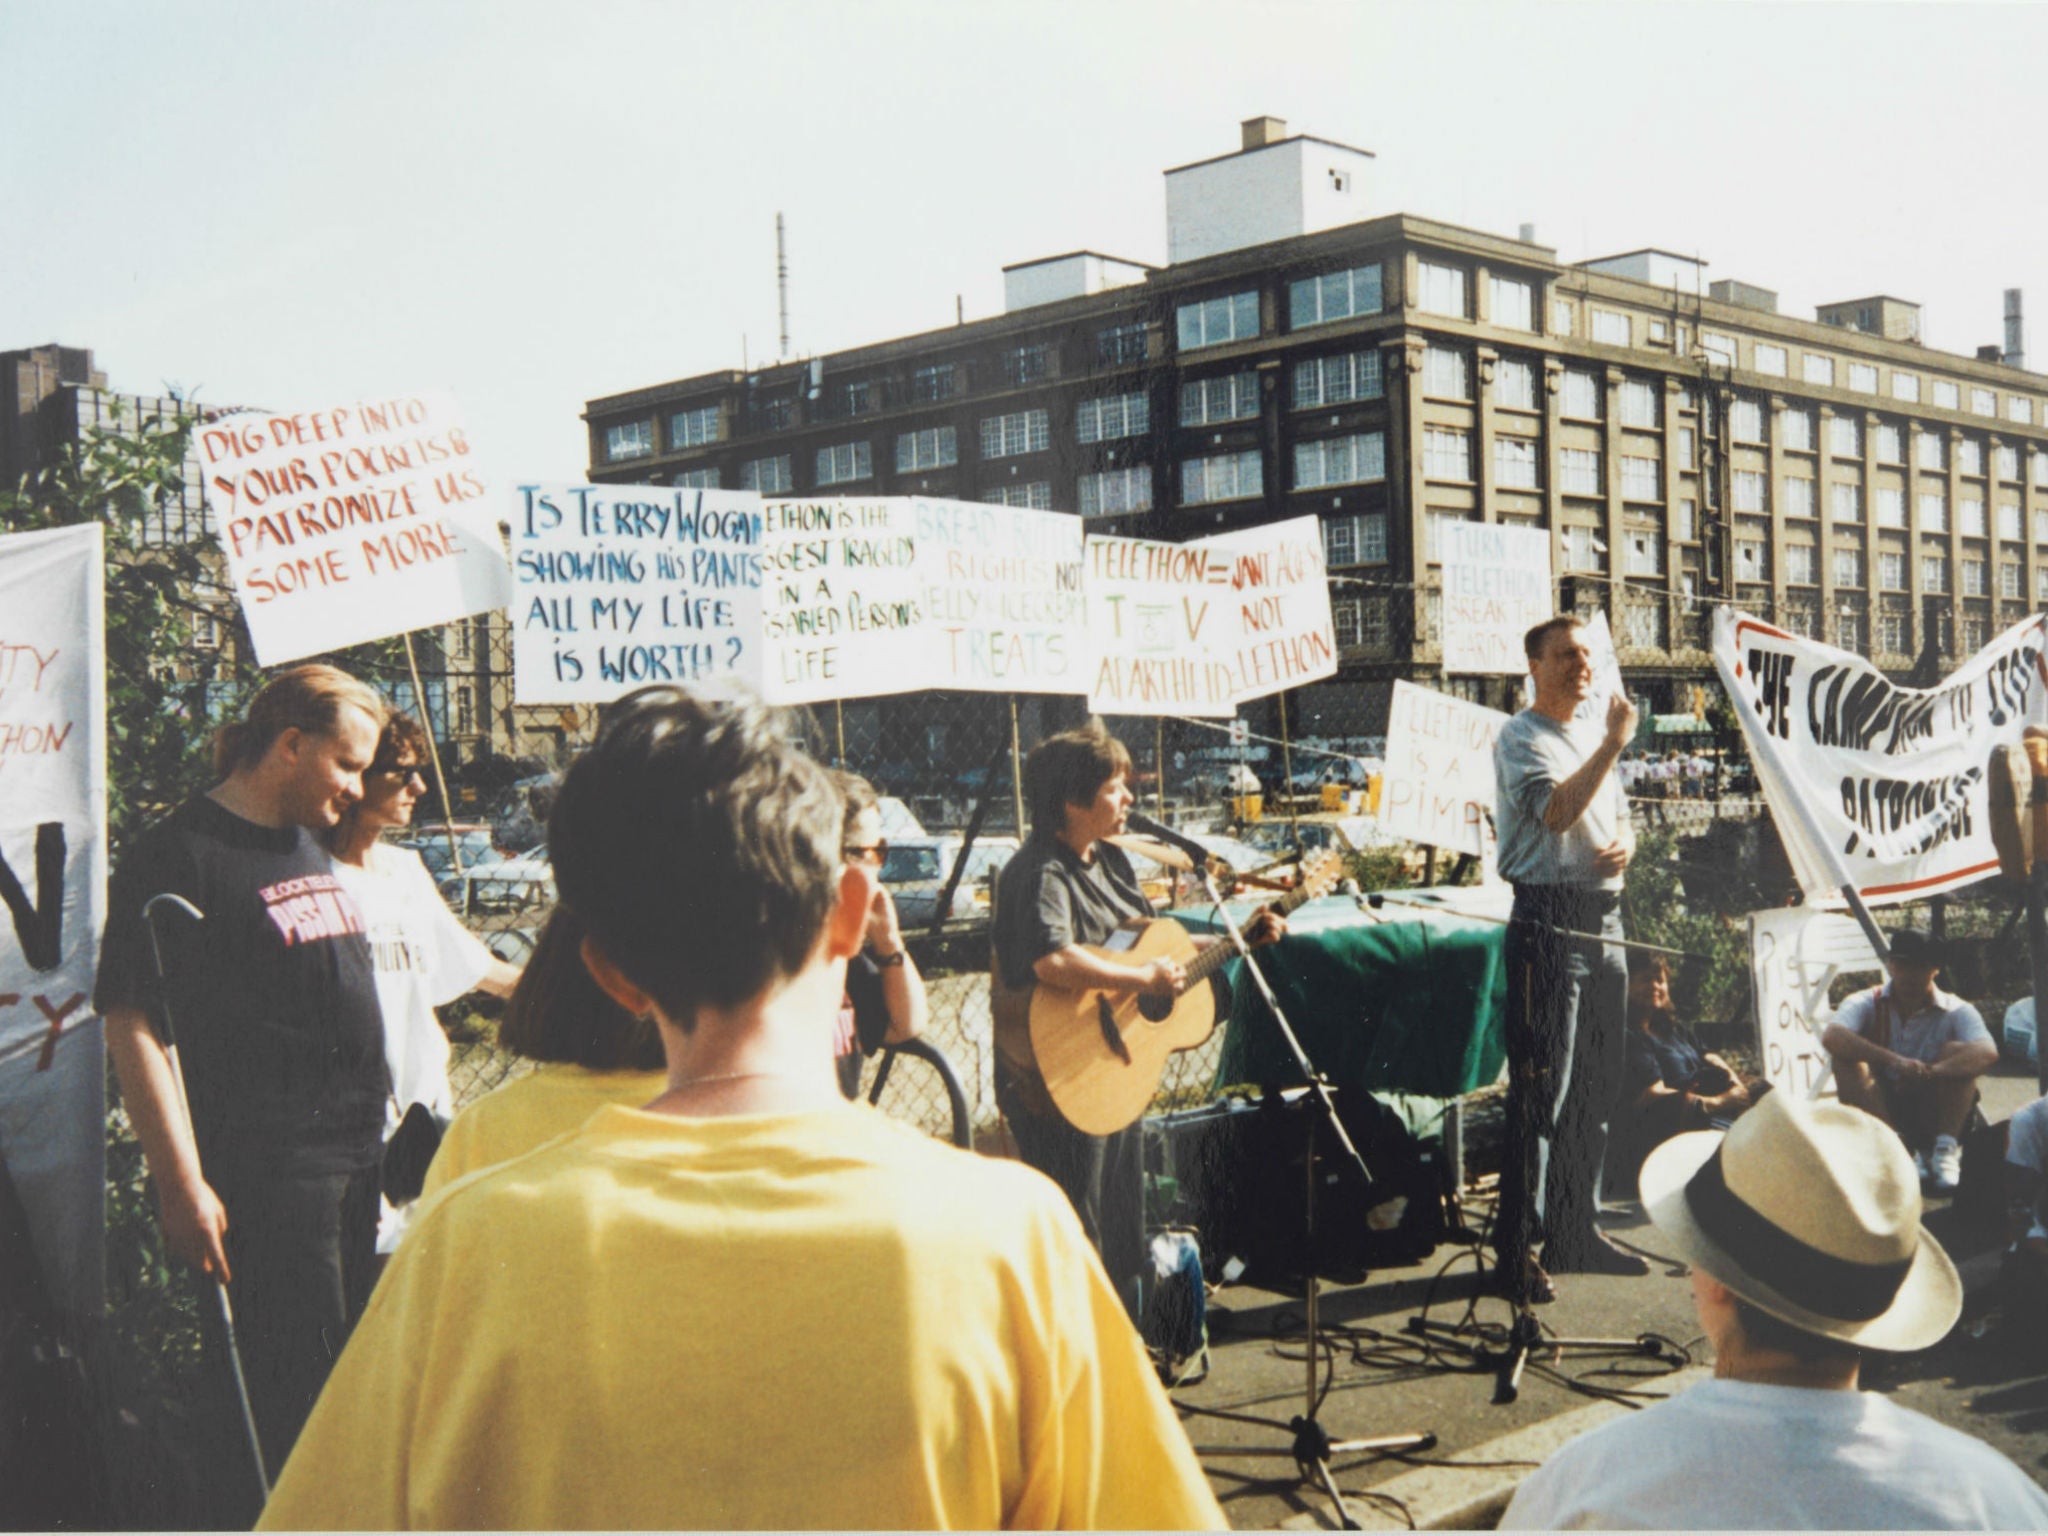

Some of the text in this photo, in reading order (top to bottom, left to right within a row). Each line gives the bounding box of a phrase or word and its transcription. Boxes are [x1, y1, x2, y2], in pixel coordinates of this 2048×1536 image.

[202, 398, 427, 464] DIG DEEP INTO
[213, 457, 318, 515] YOUR
[227, 468, 487, 559] PATRONIZE US
[567, 487, 671, 539] TERRY
[916, 502, 996, 547] BREAD
[245, 520, 467, 603] SOME MORE
[517, 542, 646, 584] SHOWING
[692, 548, 762, 589] PANTS
[1452, 526, 1505, 560] TURN
[816, 578, 832, 599] A
[947, 547, 1084, 592] RIGHTS NOT
[1449, 562, 1542, 600] TELETHON
[525, 589, 734, 634] ALL MY LIFE
[1105, 593, 1209, 642] T V
[1242, 595, 1288, 634] NOT
[782, 646, 840, 684] LIFE
[943, 627, 1070, 679] TREATS
[1748, 648, 1796, 740] THE
[1442, 756, 1462, 783] A
